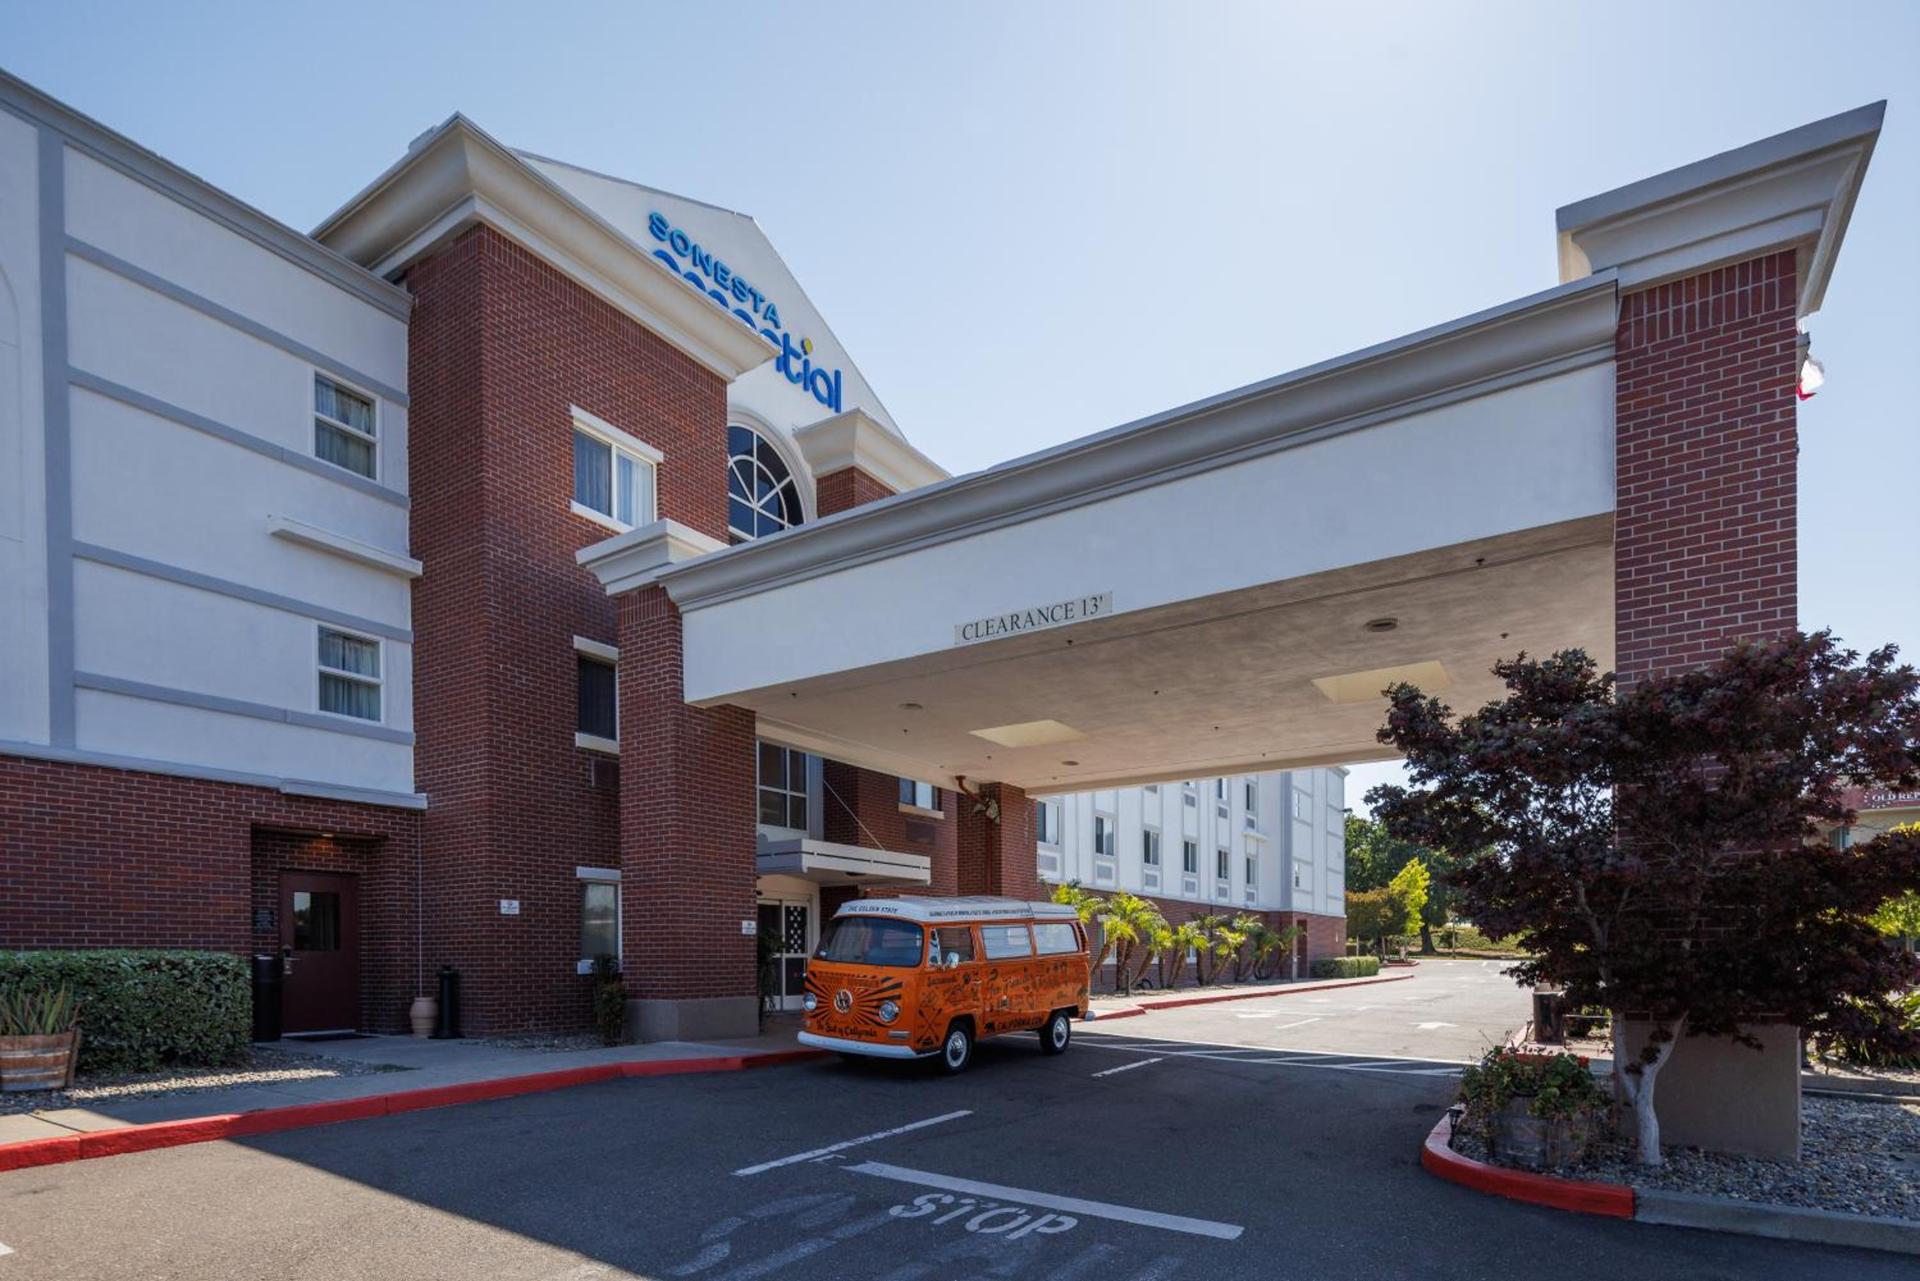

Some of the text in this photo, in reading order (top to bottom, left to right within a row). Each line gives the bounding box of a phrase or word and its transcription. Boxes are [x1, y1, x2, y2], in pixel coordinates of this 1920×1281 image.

[648, 211, 782, 330] SONESTA
[962, 602, 1074, 640] CLEARANCE
[888, 1192, 1079, 1240] STOP
